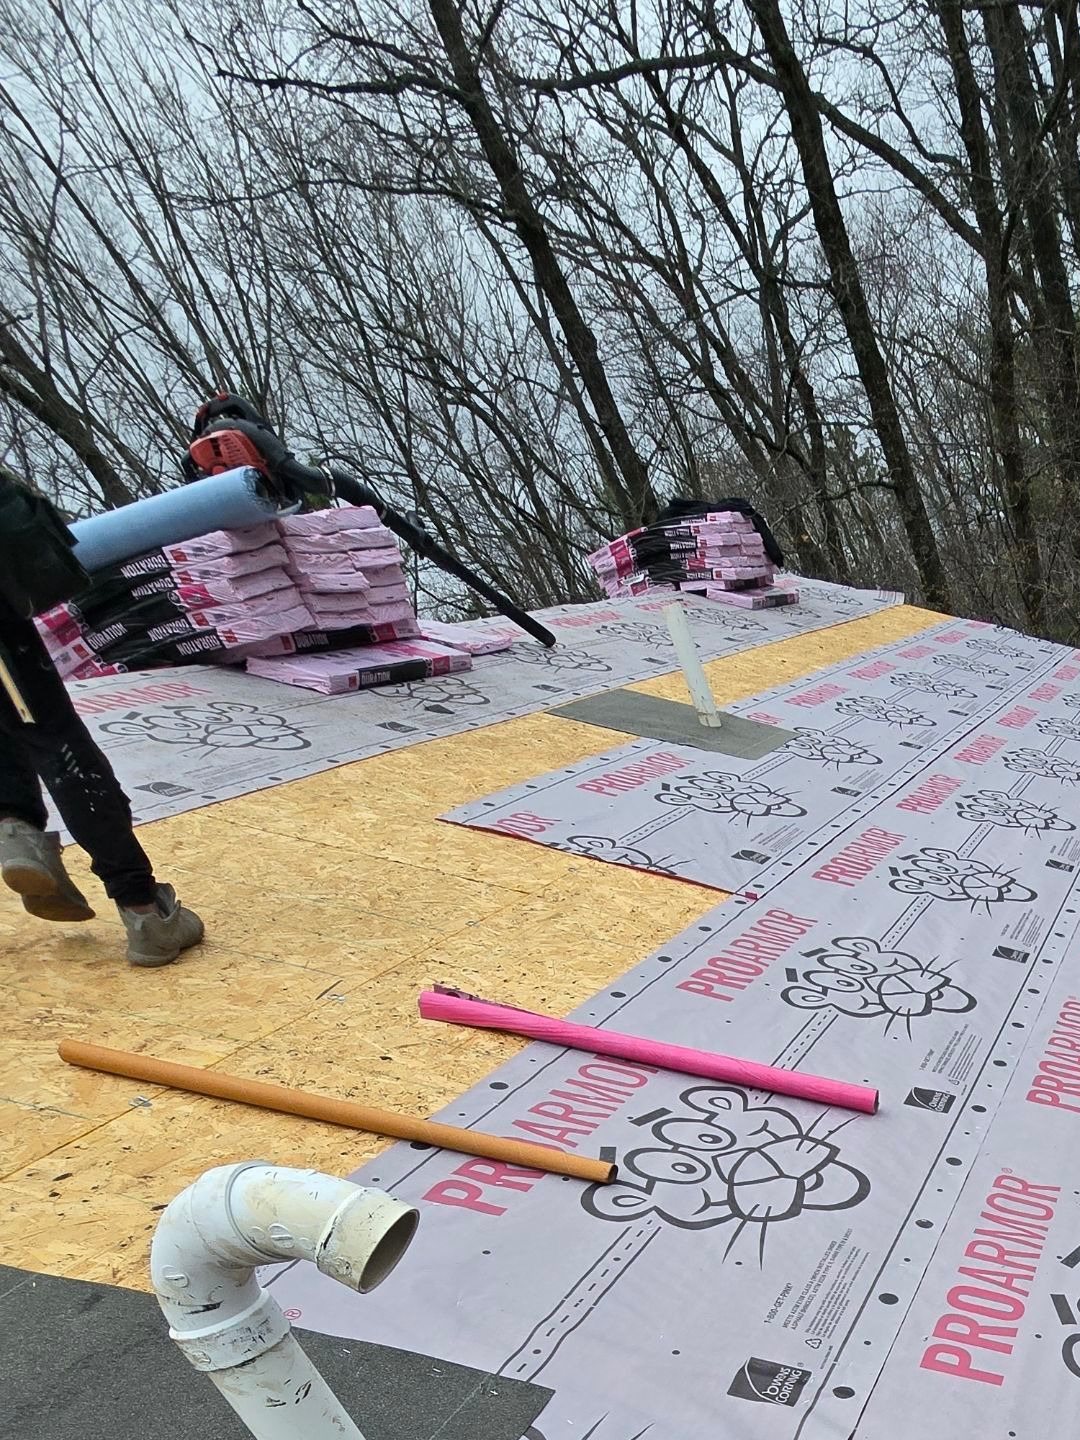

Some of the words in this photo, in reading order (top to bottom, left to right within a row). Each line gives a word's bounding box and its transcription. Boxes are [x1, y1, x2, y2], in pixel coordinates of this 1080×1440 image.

[88, 622, 128, 649] DURATION
[577, 752, 695, 797] PROARMOR
[812, 826, 907, 888] PROARMOR
[676, 908, 819, 1002] PROARMOR
[422, 1055, 658, 1216] PRARMO
